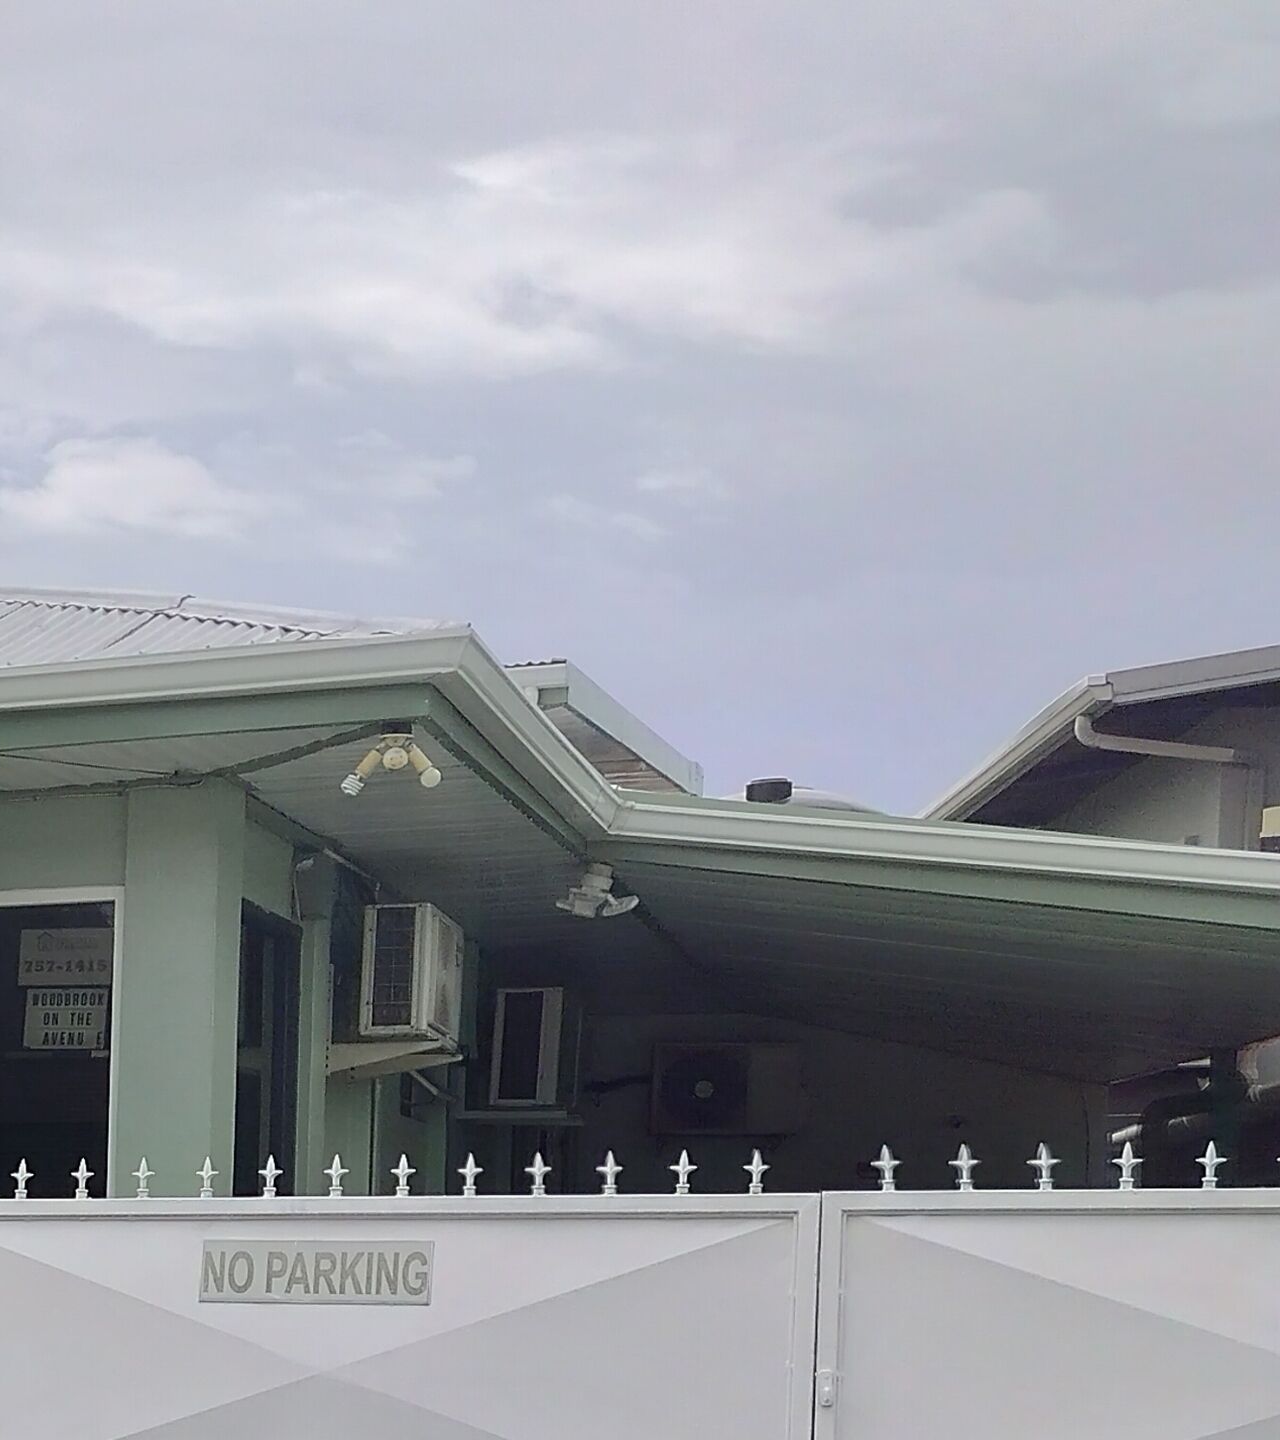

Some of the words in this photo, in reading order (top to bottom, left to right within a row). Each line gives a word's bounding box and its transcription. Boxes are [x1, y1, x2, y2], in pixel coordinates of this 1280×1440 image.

[43, 1012, 59, 1026] ON
[70, 1012, 93, 1026] THE
[203, 1251, 254, 1294] NO
[265, 1251, 429, 1295] PARKING
